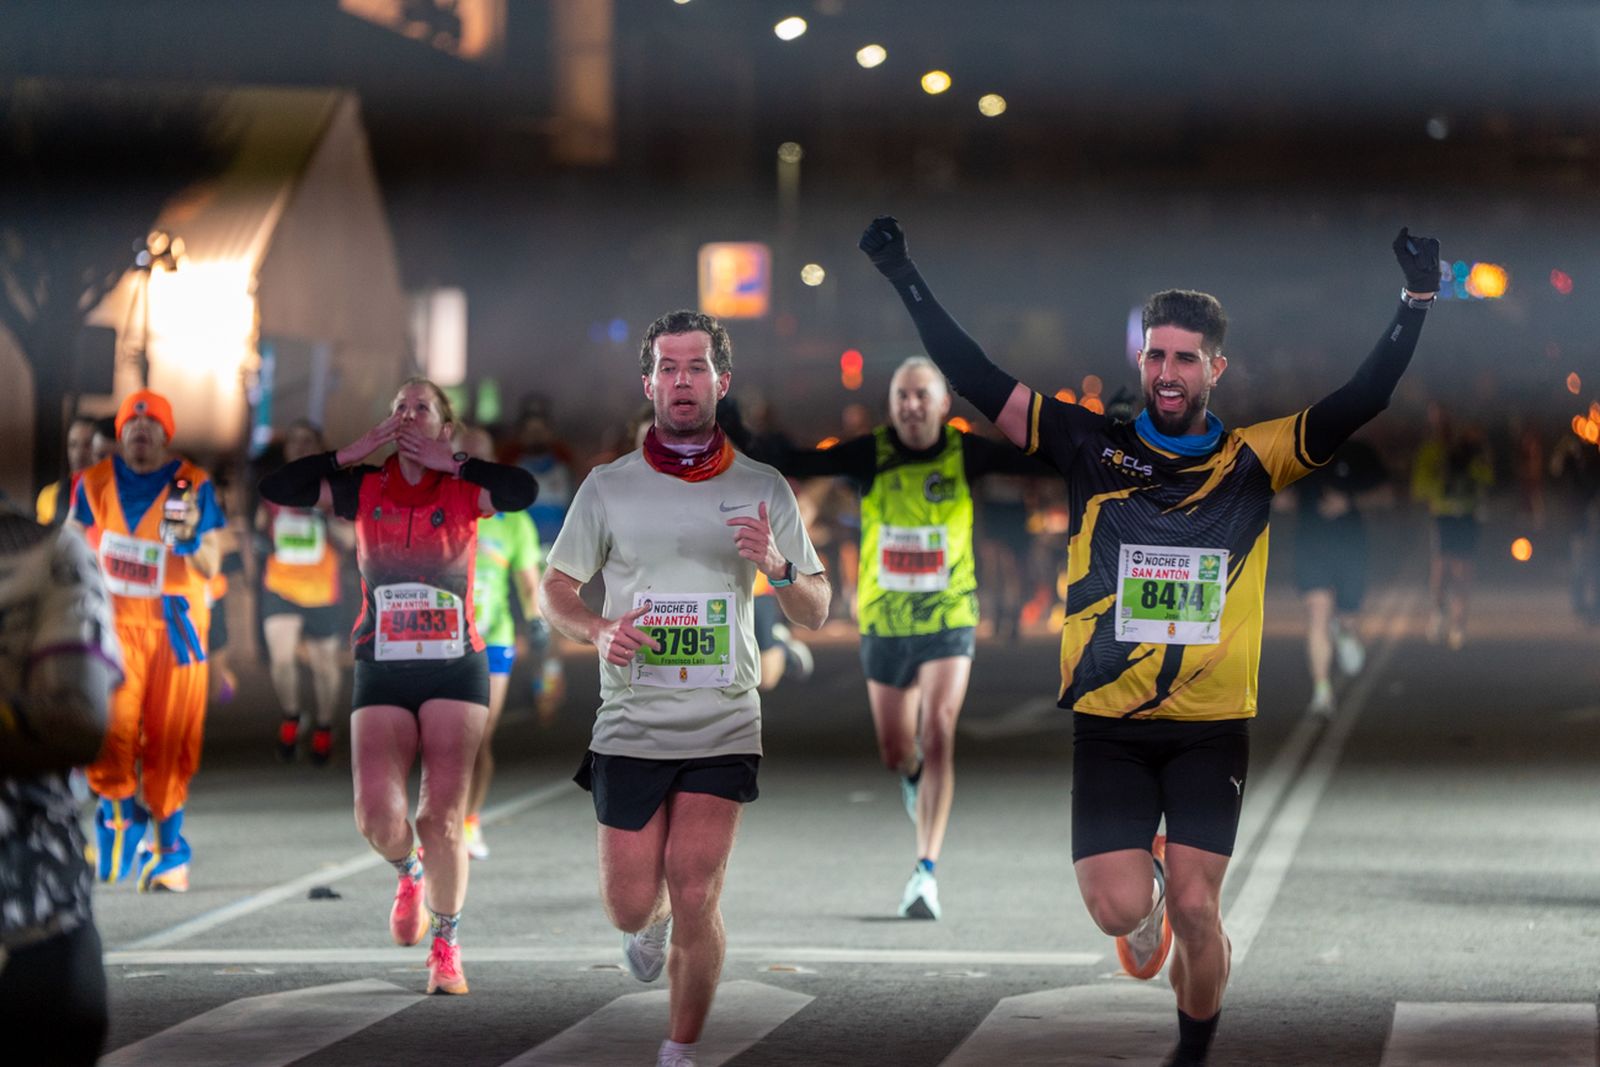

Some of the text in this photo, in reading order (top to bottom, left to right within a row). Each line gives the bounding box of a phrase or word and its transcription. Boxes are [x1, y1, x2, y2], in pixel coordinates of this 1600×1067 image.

[1144, 557, 1190, 568] NOCHE DE
[1131, 567, 1153, 578] SAN
[1154, 568, 1190, 580] ANTÓN
[394, 591, 417, 600] NOCHE
[419, 590, 428, 599] DE
[1141, 580, 1205, 611] 8474
[654, 604, 684, 614] NOCHE
[686, 604, 698, 614] DE
[391, 610, 447, 634] 9433
[643, 615, 662, 626] SAN
[664, 612, 698, 626] ANTÓN
[651, 627, 715, 656] 3795
